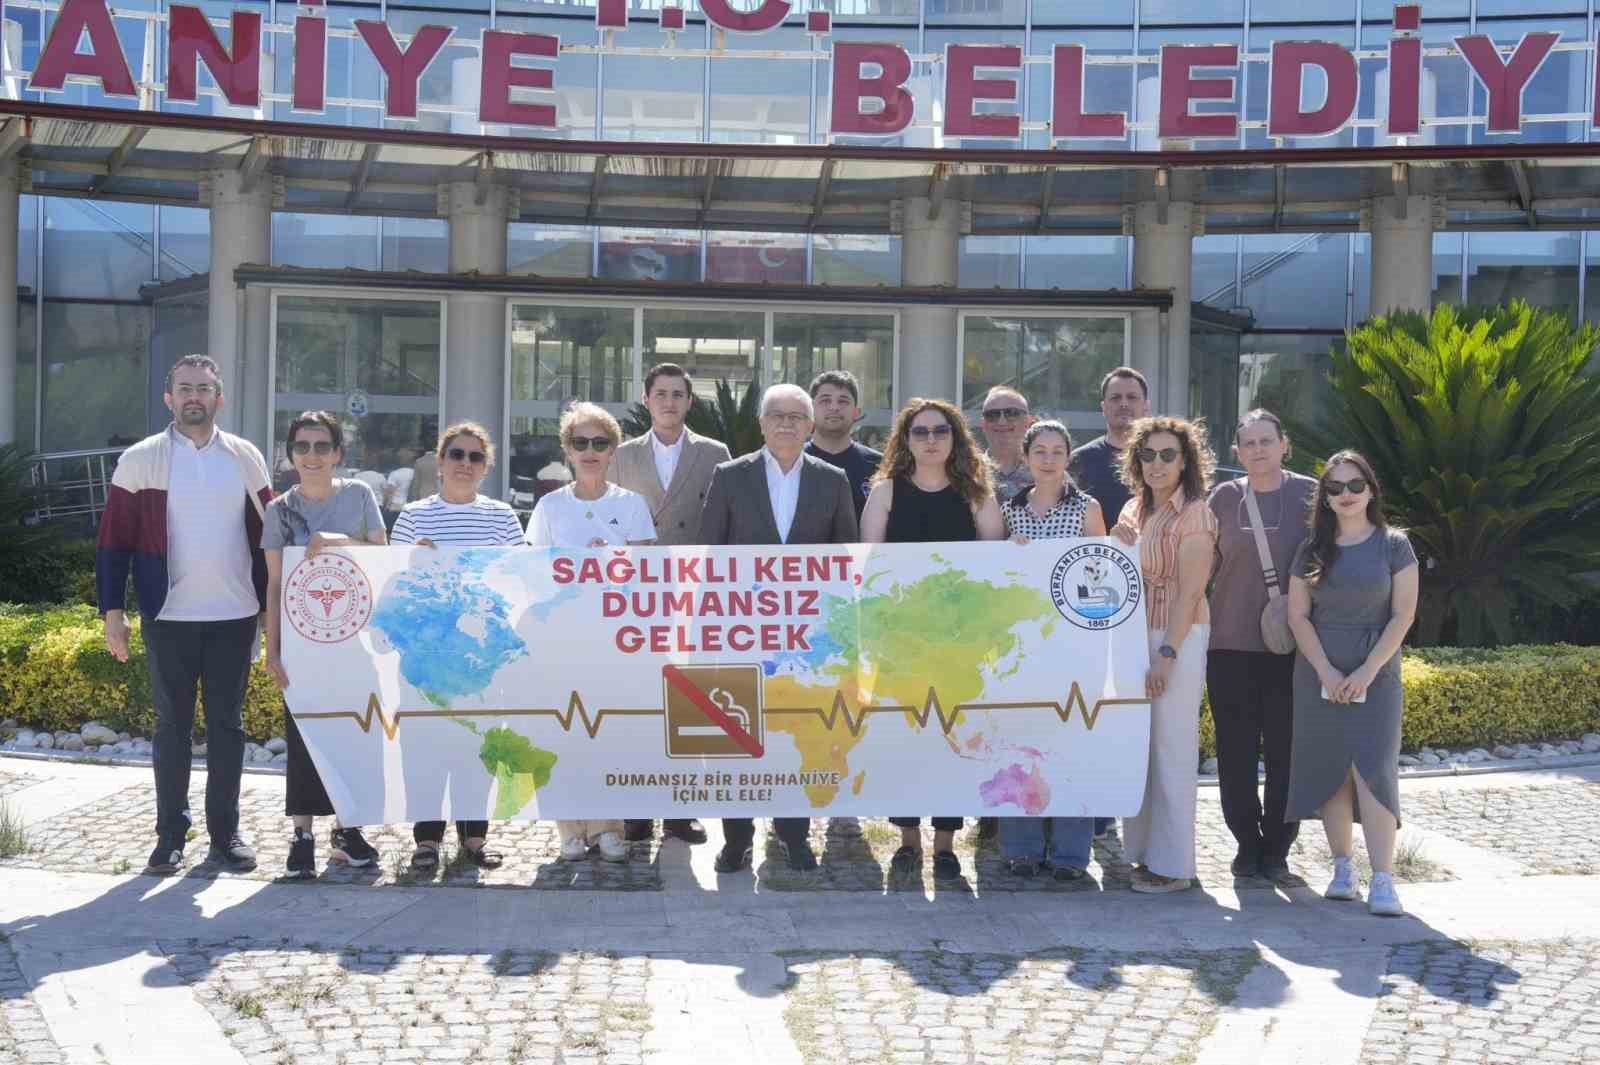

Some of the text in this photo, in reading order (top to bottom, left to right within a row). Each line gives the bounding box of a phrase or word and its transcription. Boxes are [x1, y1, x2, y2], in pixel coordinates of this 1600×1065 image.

[0, 0, 1600, 140] ANİYE BELEDİY
[552, 551, 862, 586] SAĞLIKLI KENT,
[602, 590, 820, 618] DUMANSIZ
[1088, 619, 1110, 627] 1867
[615, 624, 811, 654] GELECEK
[606, 771, 839, 786] DUMANSIZ BİR BURHANİYE
[673, 788, 773, 804] İÇİN EL ELE!
